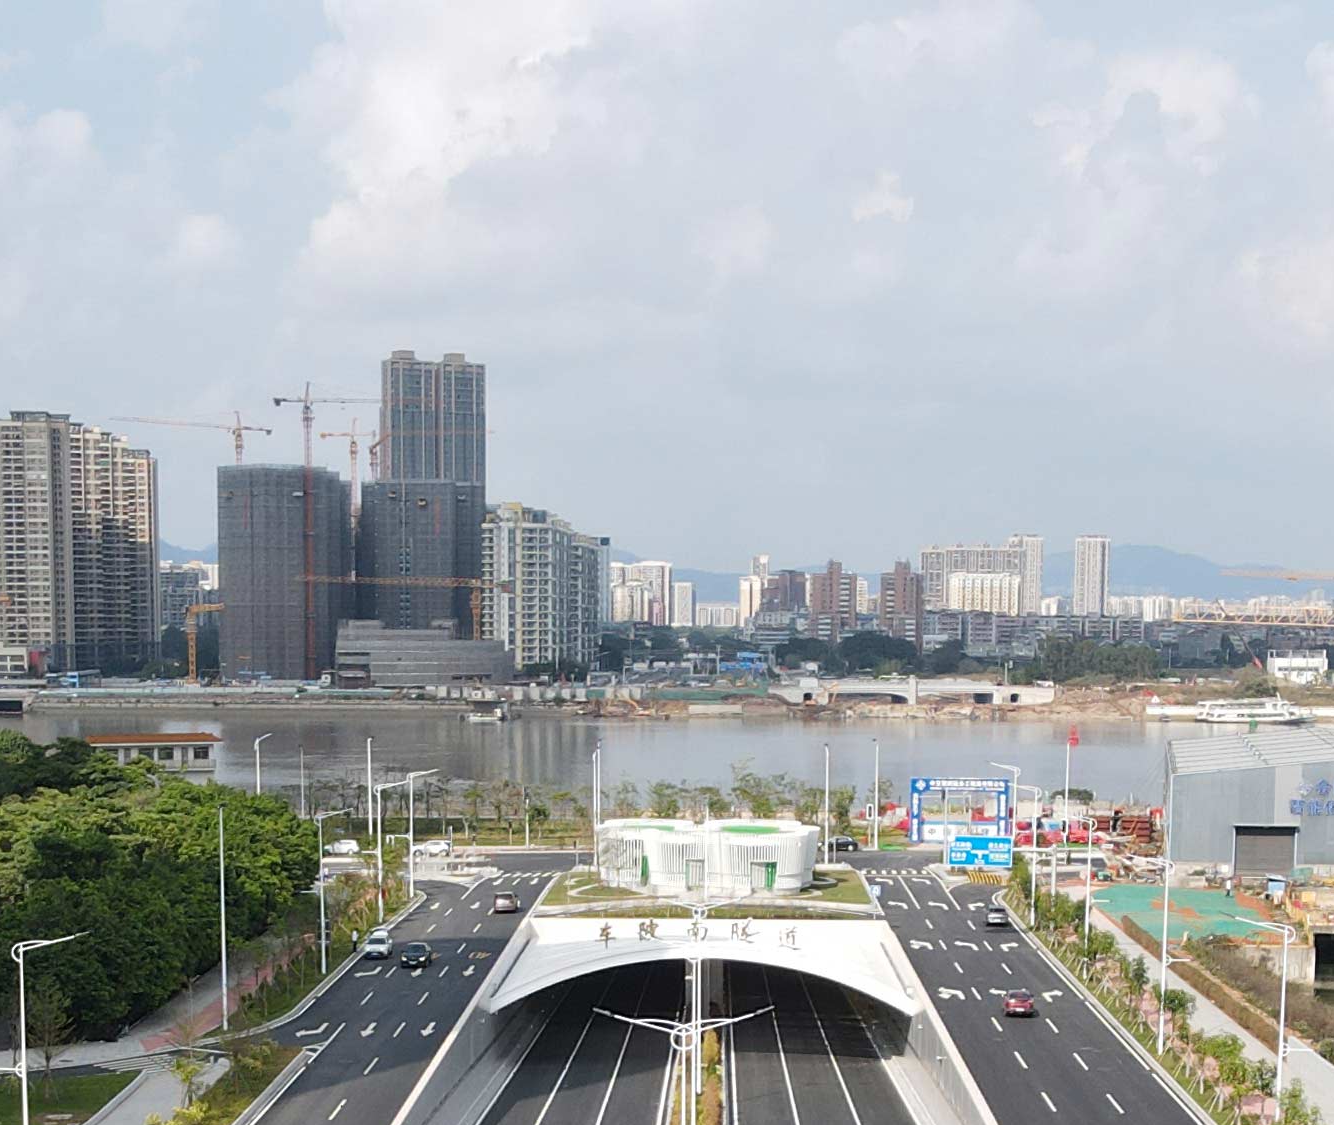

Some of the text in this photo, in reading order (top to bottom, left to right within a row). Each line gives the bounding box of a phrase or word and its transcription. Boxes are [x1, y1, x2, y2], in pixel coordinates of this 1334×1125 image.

[595, 918, 801, 951] 车陂南隧道
